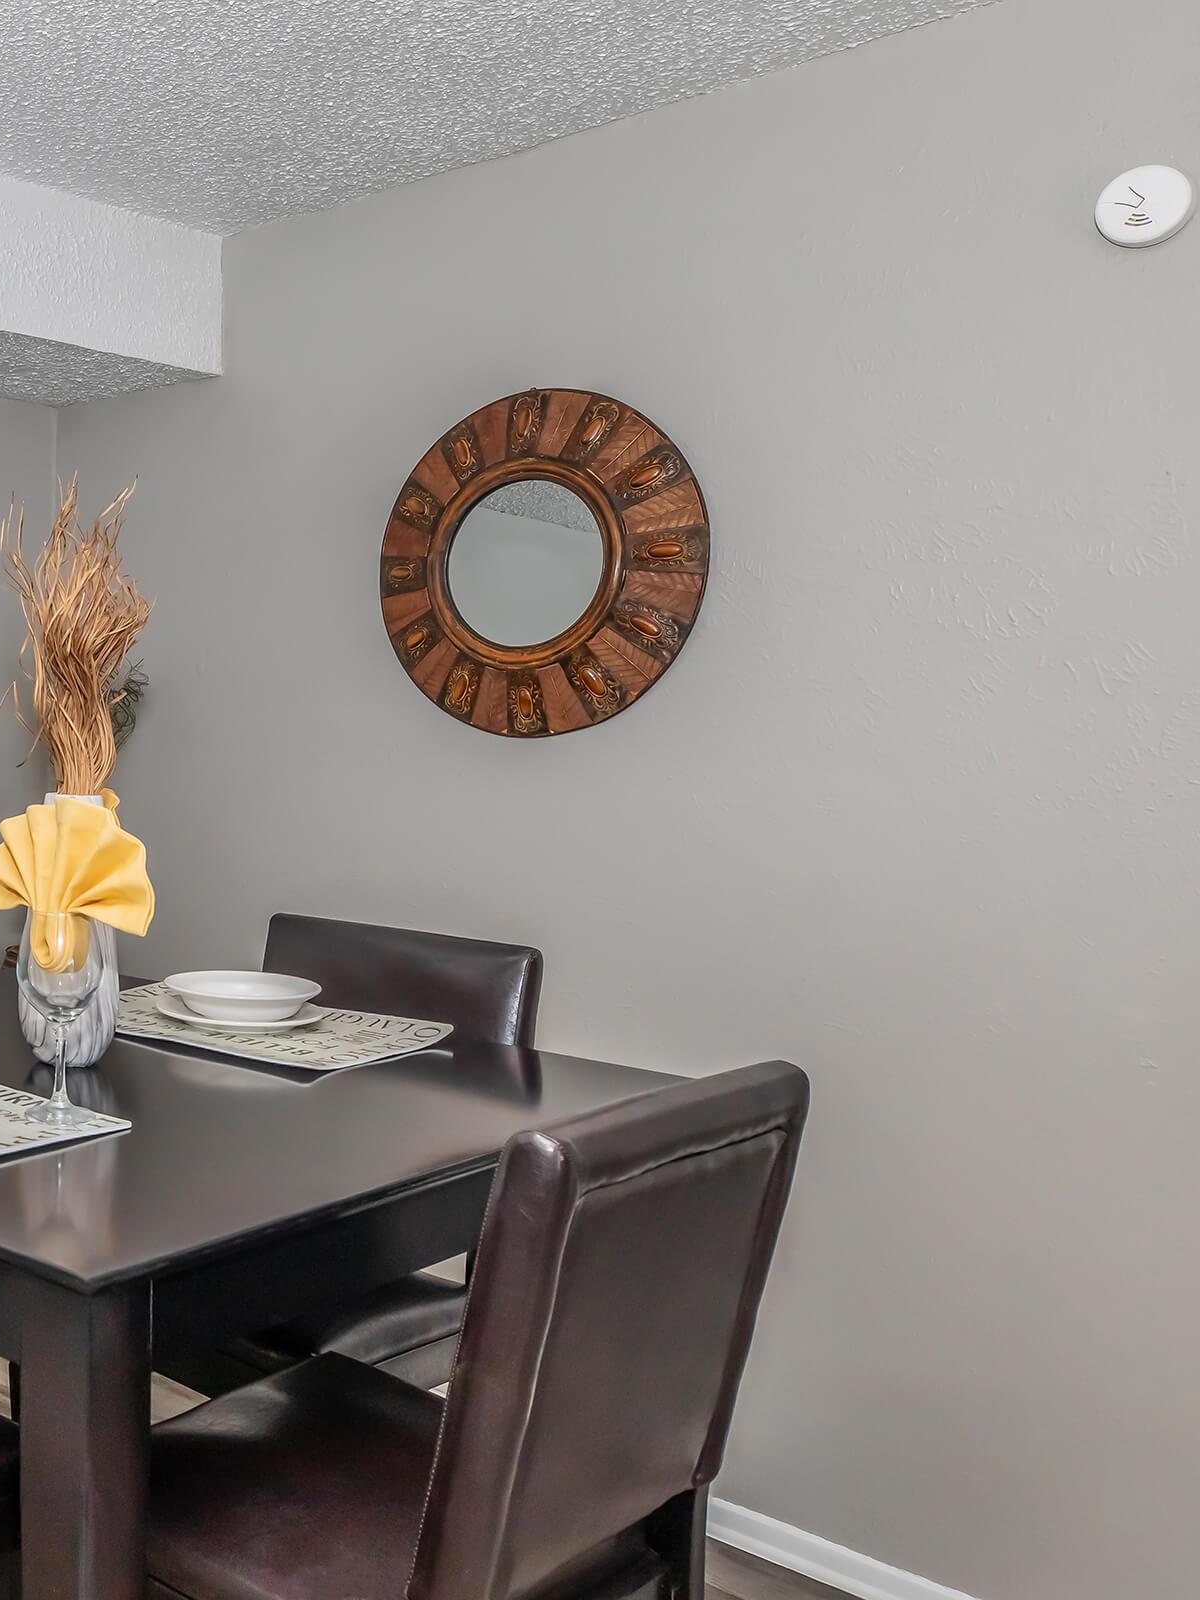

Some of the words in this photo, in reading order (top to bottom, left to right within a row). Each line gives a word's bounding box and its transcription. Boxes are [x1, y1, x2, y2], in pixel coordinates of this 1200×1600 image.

[322, 1011, 416, 1033] LAUGH
[200, 1031, 316, 1056] BELIEVE
[372, 1027, 441, 1050] OUR
